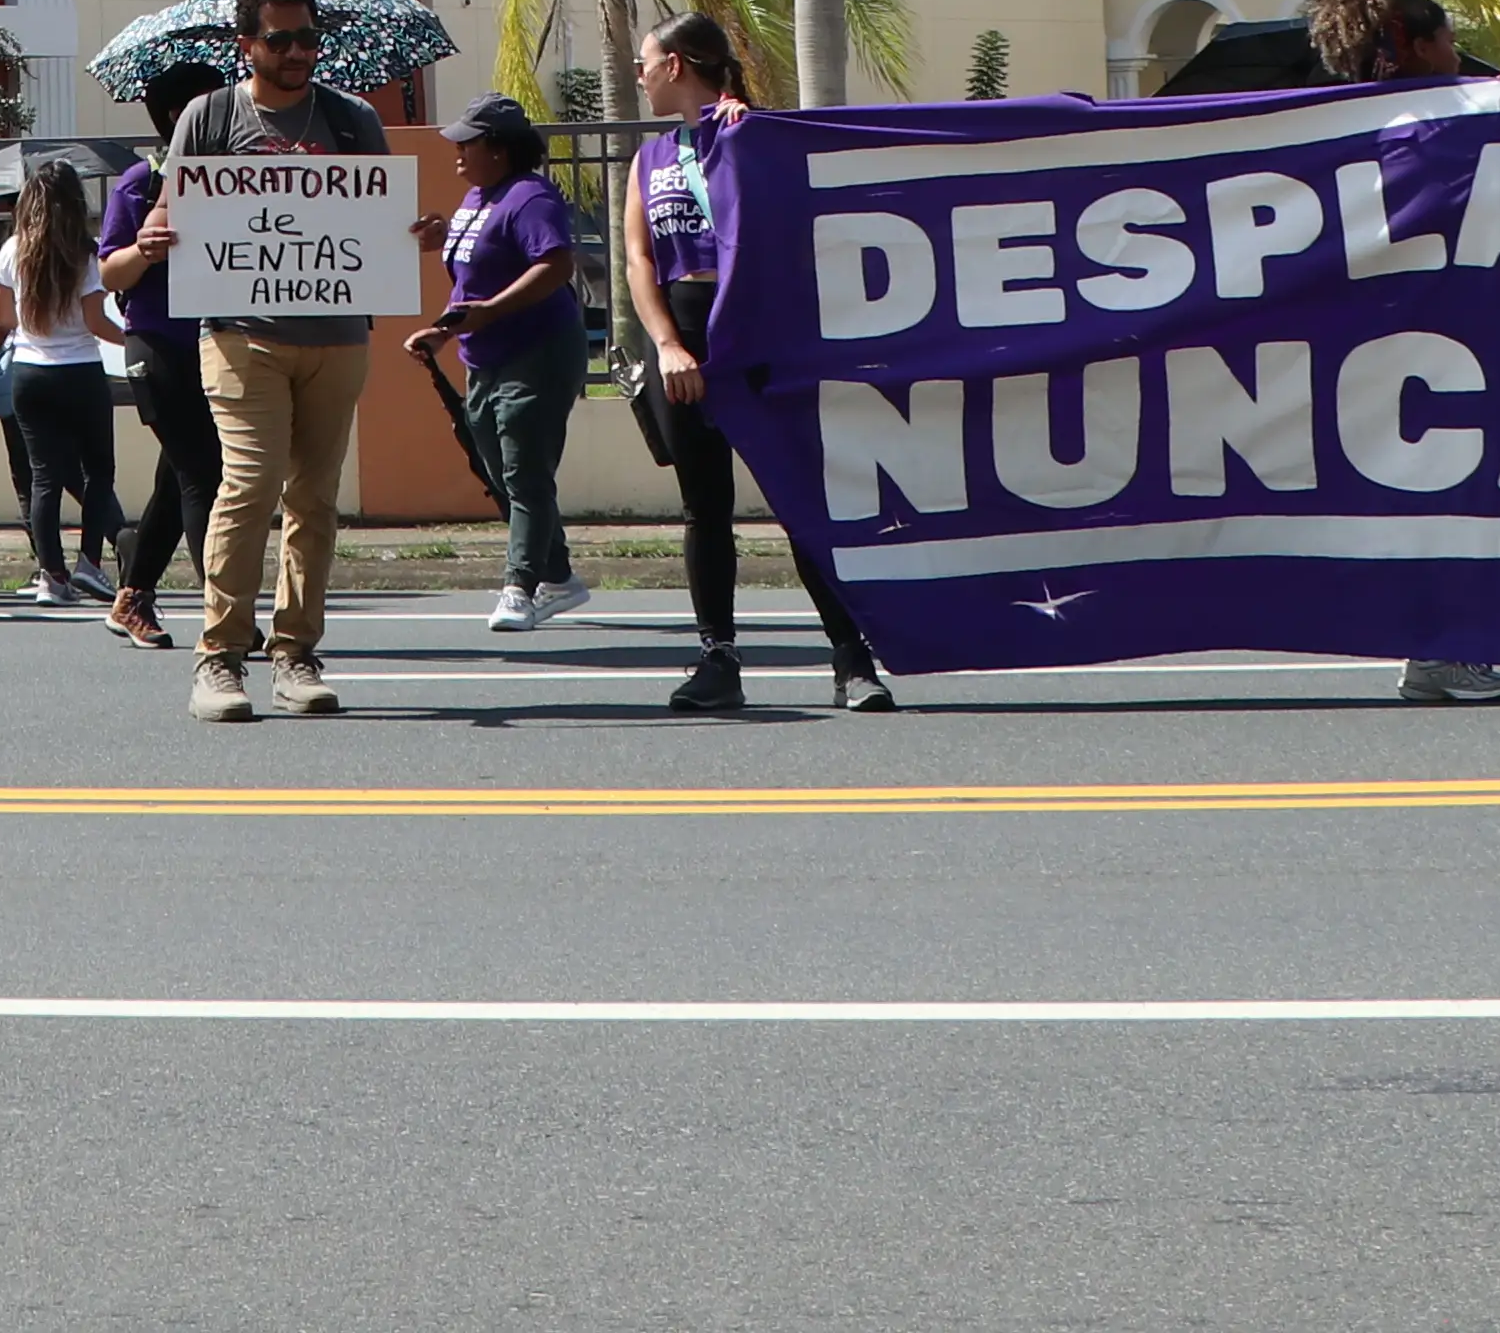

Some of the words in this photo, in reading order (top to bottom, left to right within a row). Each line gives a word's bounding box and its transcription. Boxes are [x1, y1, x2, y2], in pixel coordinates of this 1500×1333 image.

[177, 165, 388, 198] MORATORIA
[248, 207, 303, 236] de
[204, 234, 363, 272] VENTAS
[250, 277, 353, 305] AHORA
